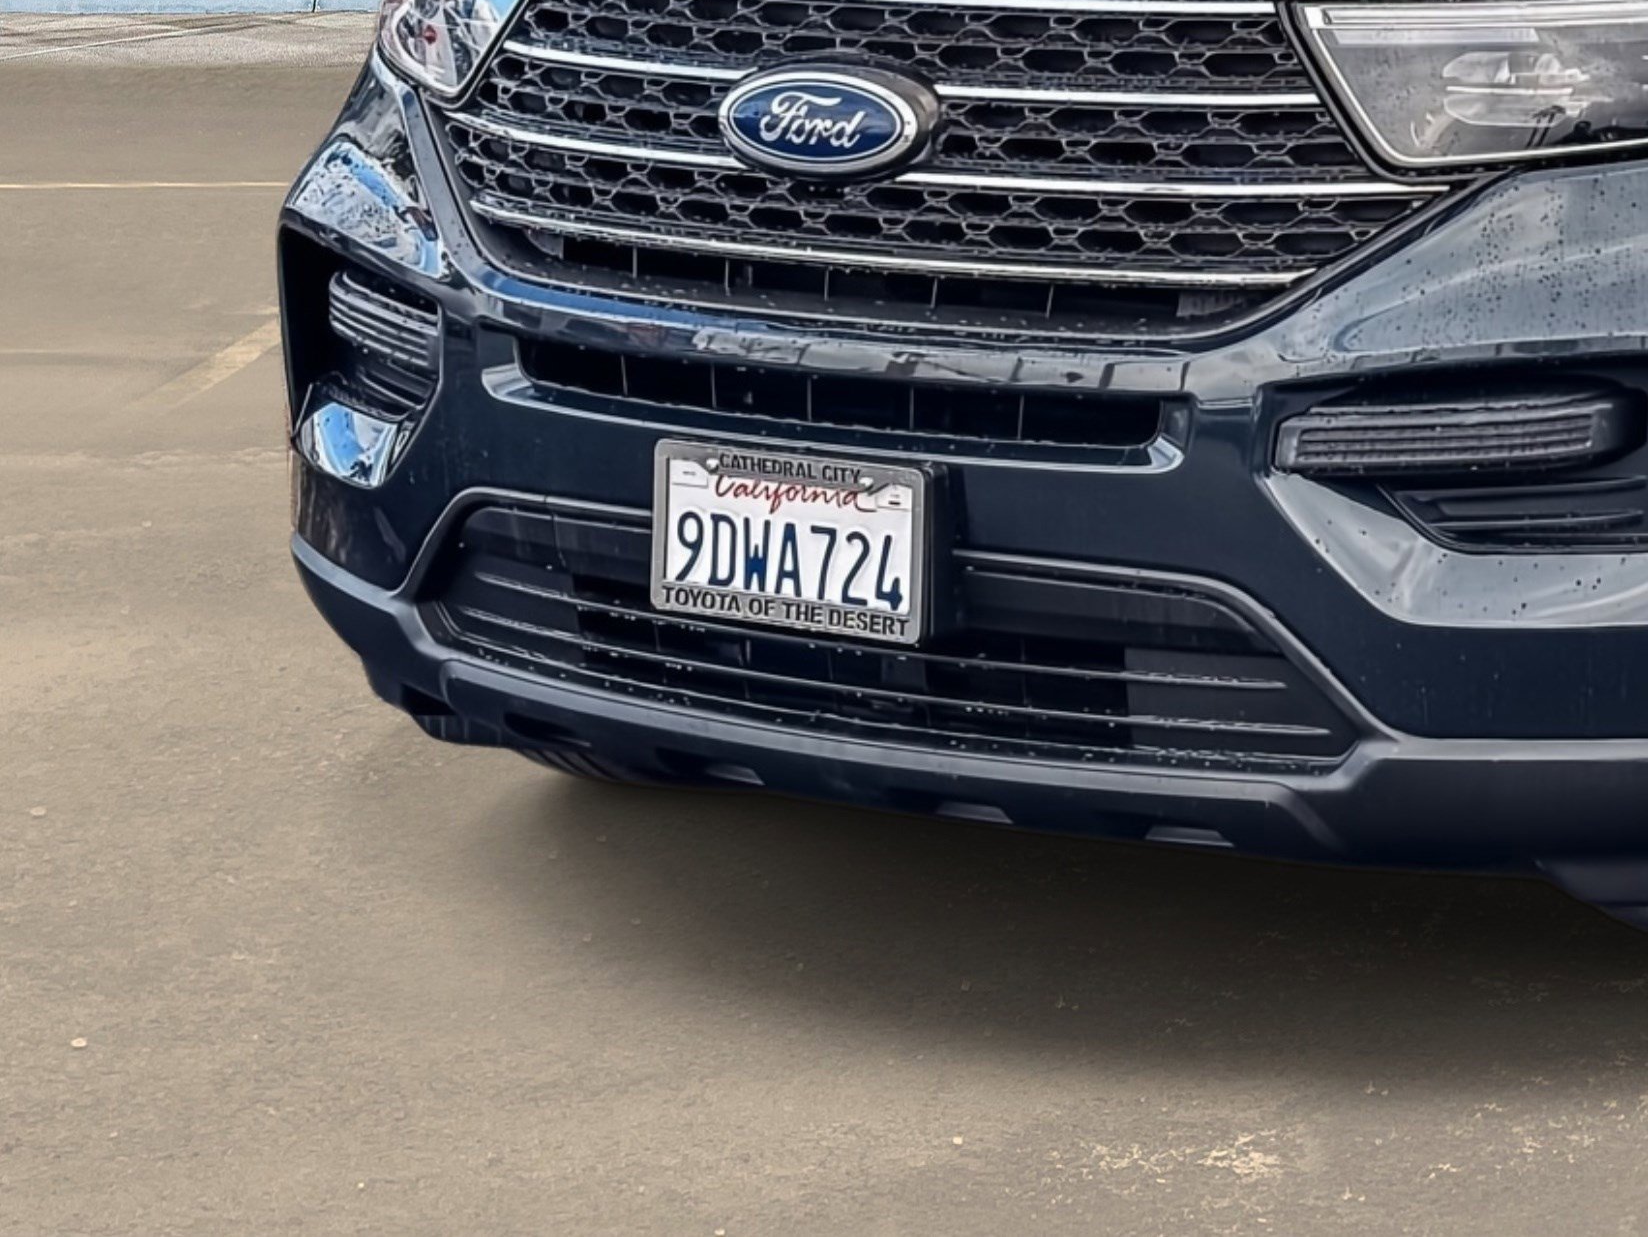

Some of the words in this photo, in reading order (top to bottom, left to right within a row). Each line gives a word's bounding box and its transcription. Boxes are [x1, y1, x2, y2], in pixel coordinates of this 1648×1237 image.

[759, 91, 867, 149] Ford
[719, 452, 817, 480] CATHEDRAL
[821, 464, 861, 484] CITY
[675, 510, 904, 611] 9DWA724
[662, 584, 741, 613] TOYOTA
[748, 597, 776, 618] OF
[782, 600, 824, 625] THE
[828, 607, 910, 637] DESERT
